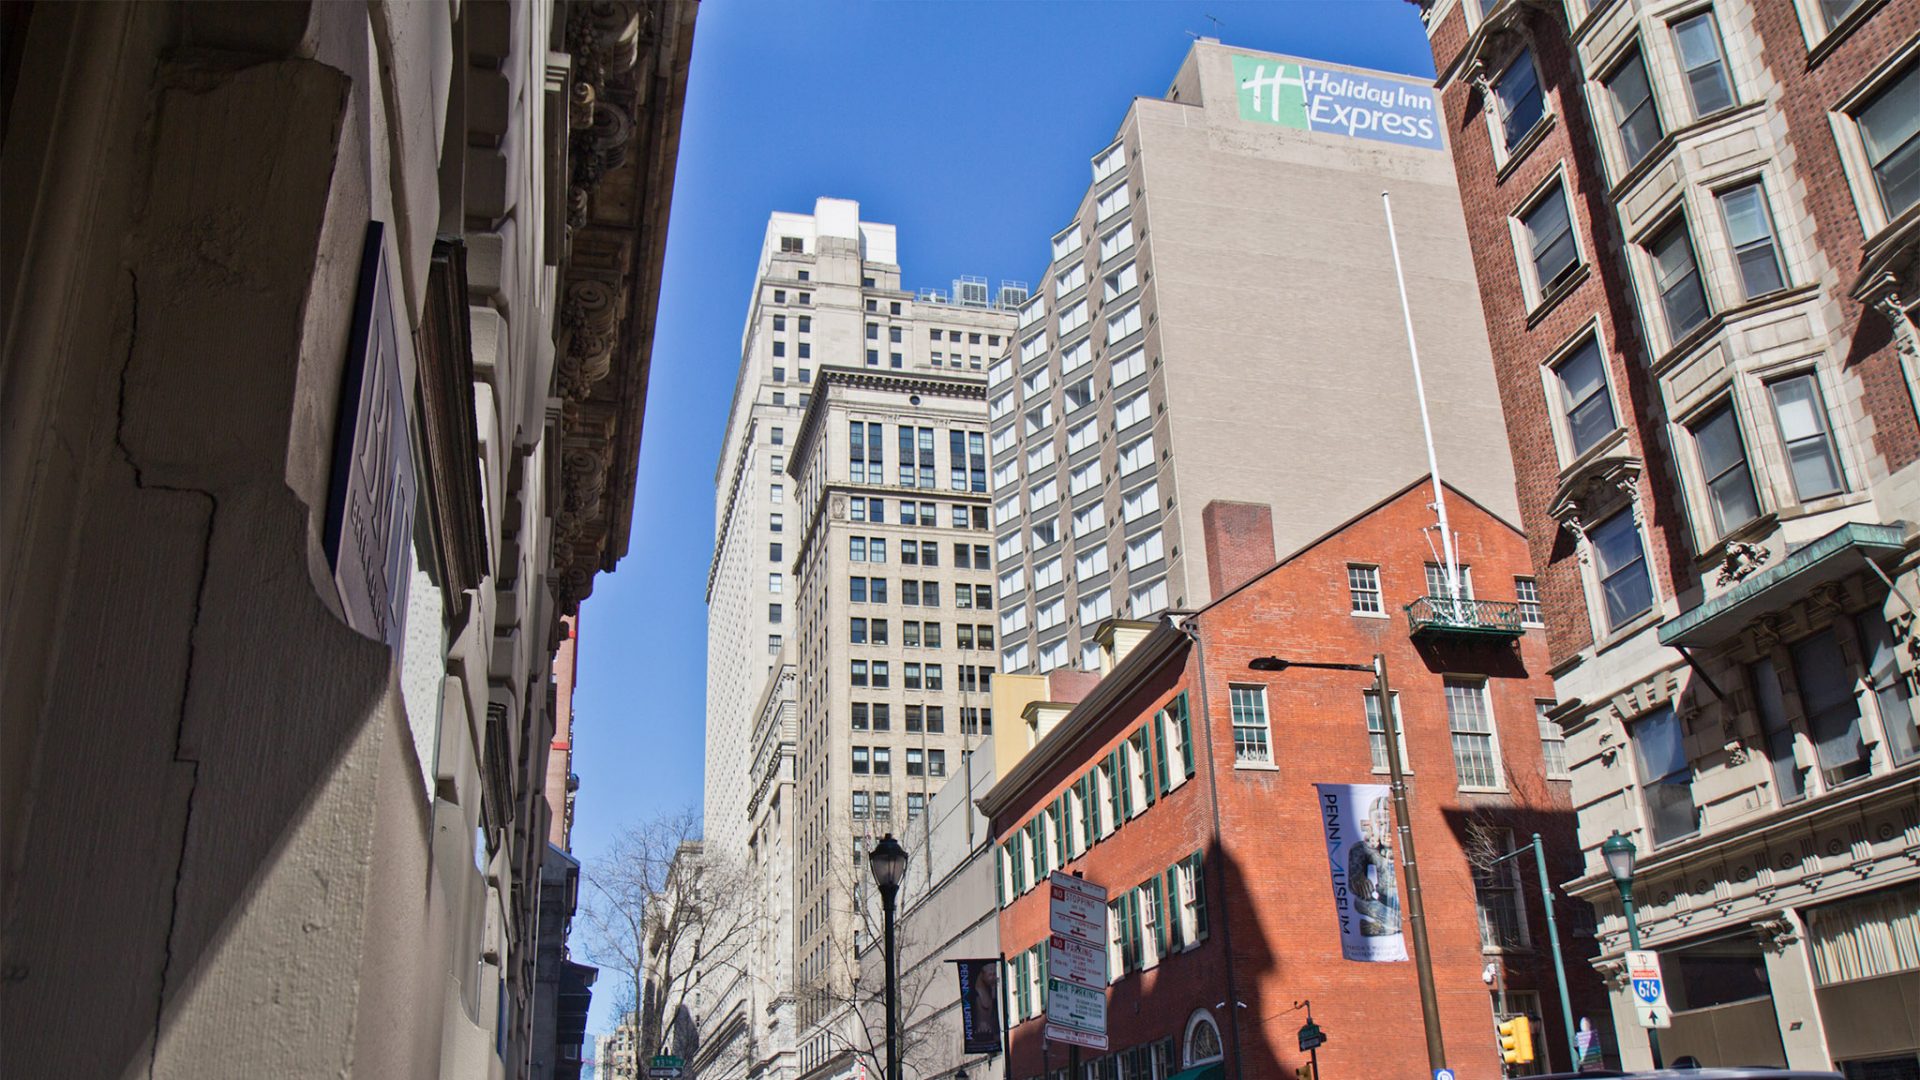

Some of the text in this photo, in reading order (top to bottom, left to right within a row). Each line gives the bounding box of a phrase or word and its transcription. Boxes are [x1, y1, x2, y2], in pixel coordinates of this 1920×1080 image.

[1305, 70, 1432, 111] Holiday Inn
[1310, 94, 1434, 140] Express
[1324, 794, 1341, 844] PENN
[1053, 888, 1063, 900] NO
[1066, 892, 1095, 909] STOPPING
[1053, 938, 1063, 948] NO
[1066, 942, 1093, 958] PARKING
[960, 963, 969, 991] PENN
[1638, 980, 1658, 998] 676
[1059, 983, 1068, 993] HR
[1071, 985, 1098, 1001] PARKING
